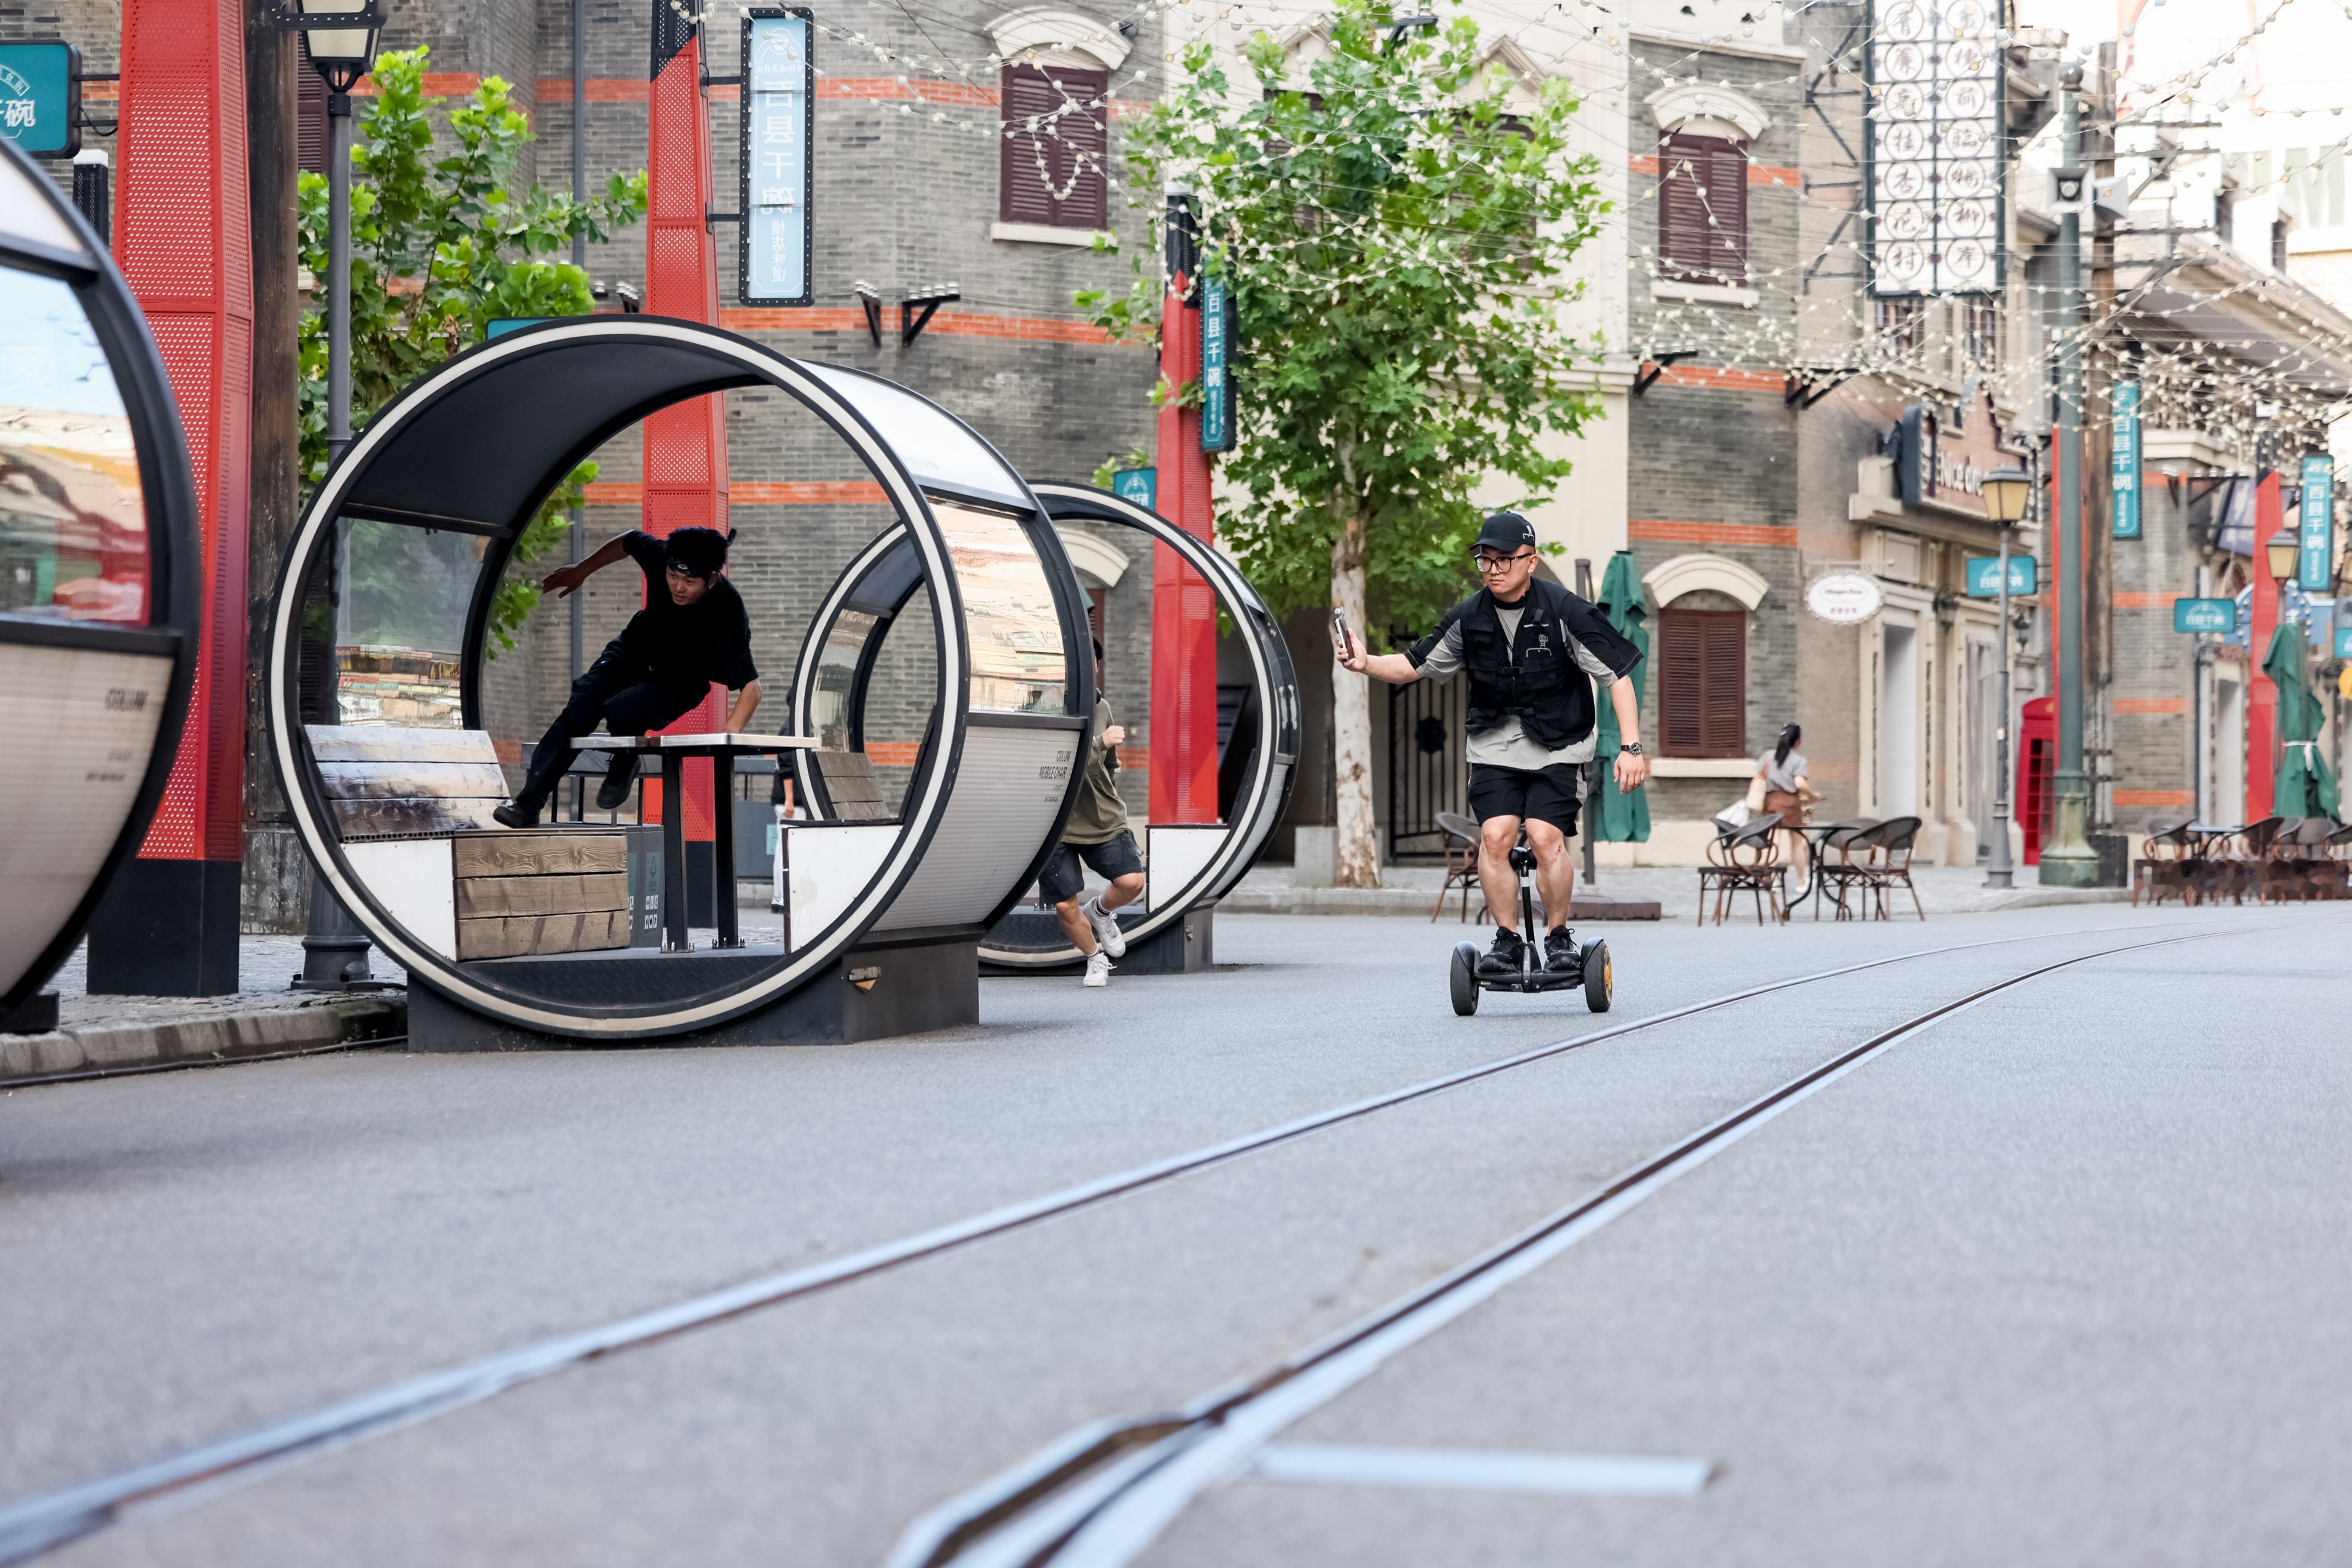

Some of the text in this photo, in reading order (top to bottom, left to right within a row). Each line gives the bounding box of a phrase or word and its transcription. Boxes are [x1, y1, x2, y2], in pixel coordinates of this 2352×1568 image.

[0, 99, 36, 128] 碗
[1208, 293, 1221, 387] 百县千碗
[2306, 485, 2325, 550] 百县千碗
[1980, 576, 2024, 588] 百县碗
[1038, 766, 1055, 780] MOBILE
